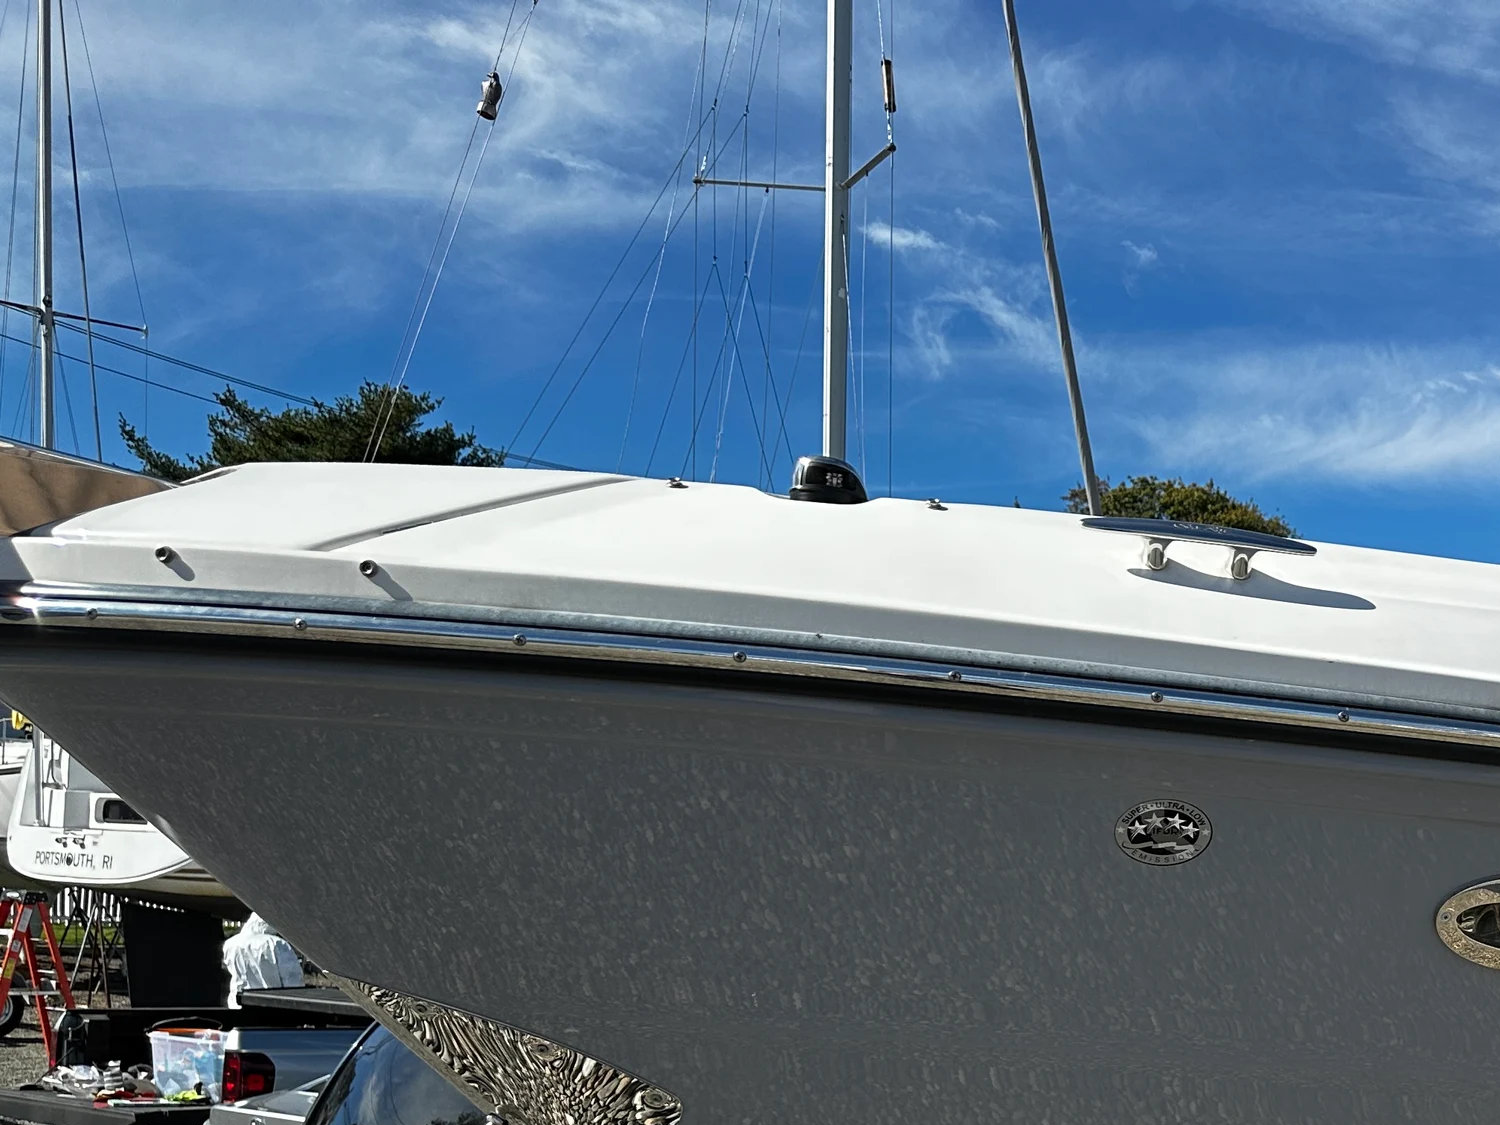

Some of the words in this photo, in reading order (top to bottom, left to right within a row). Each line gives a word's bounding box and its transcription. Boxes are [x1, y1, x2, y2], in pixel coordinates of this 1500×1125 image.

[1122, 804, 1149, 824] SUPER
[1155, 802, 1185, 812] ULTRA
[1189, 809, 1206, 826] LOW
[102, 855, 113, 869] RI
[1131, 848, 1194, 863] EMISSION
